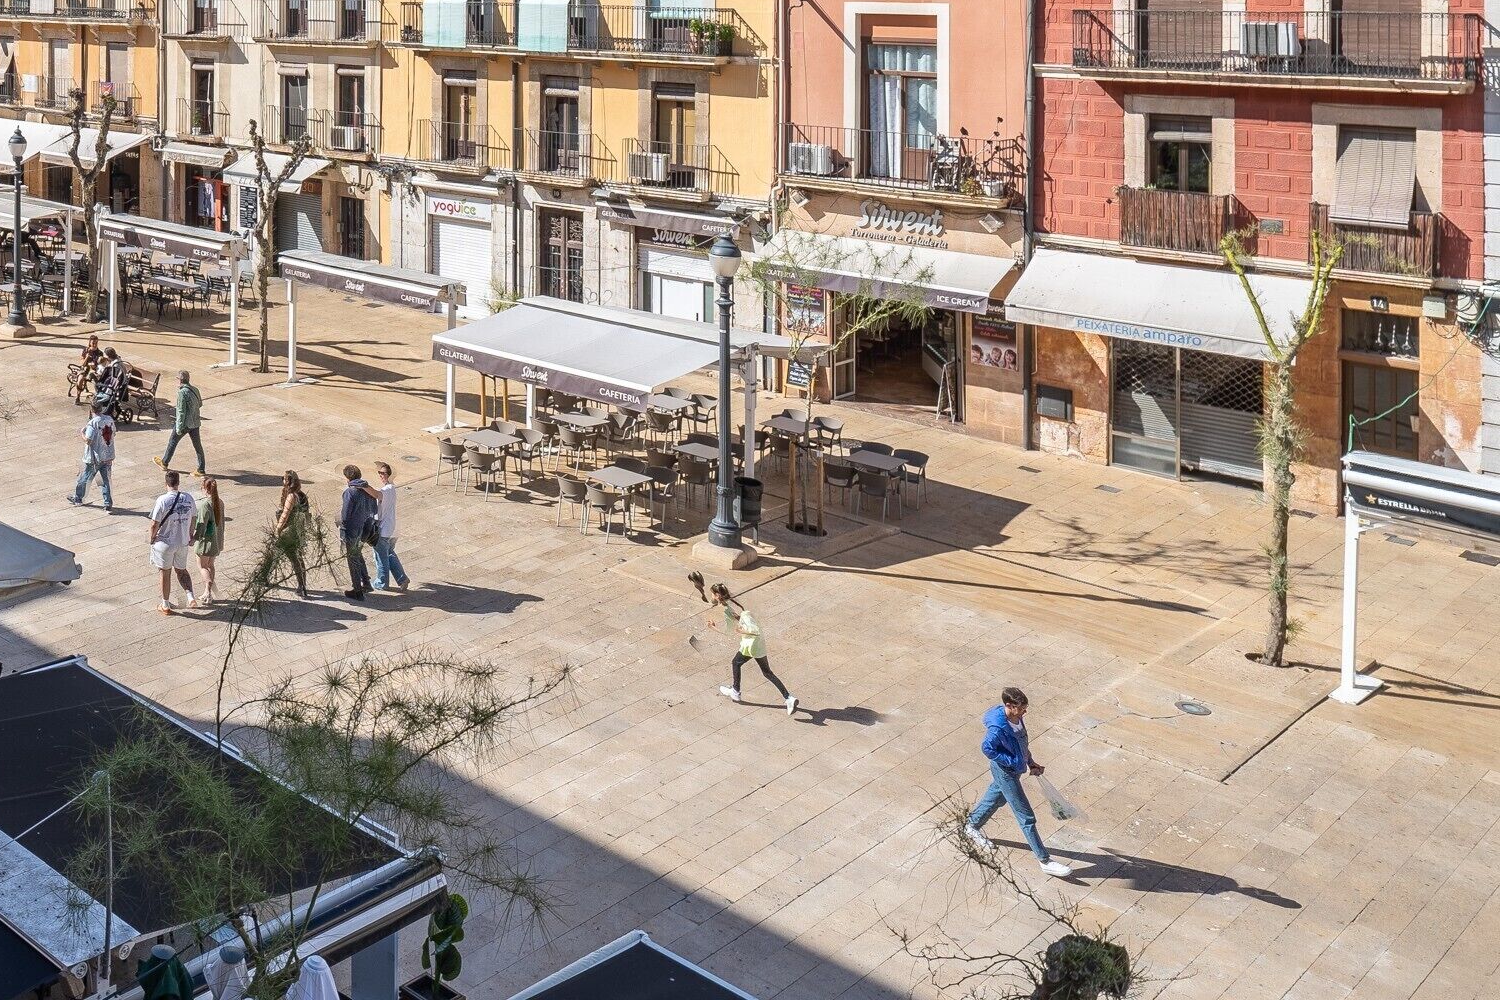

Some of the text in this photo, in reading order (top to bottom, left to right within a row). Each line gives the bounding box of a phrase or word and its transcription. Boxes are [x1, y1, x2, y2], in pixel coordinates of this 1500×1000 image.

[856, 197, 944, 236] Sirvent
[652, 228, 695, 245] Sirvent
[284, 268, 311, 280] GELATERIA
[400, 294, 431, 307] CAFETERIA
[936, 295, 980, 308] ICE CREAM
[1372, 298, 1384, 309] 14
[1143, 328, 1202, 347] amparo
[439, 348, 474, 364] GELATERIA
[521, 365, 548, 382] Sirvent
[599, 387, 641, 405] CAFETERIA
[1377, 497, 1420, 512] ESTRELLA
